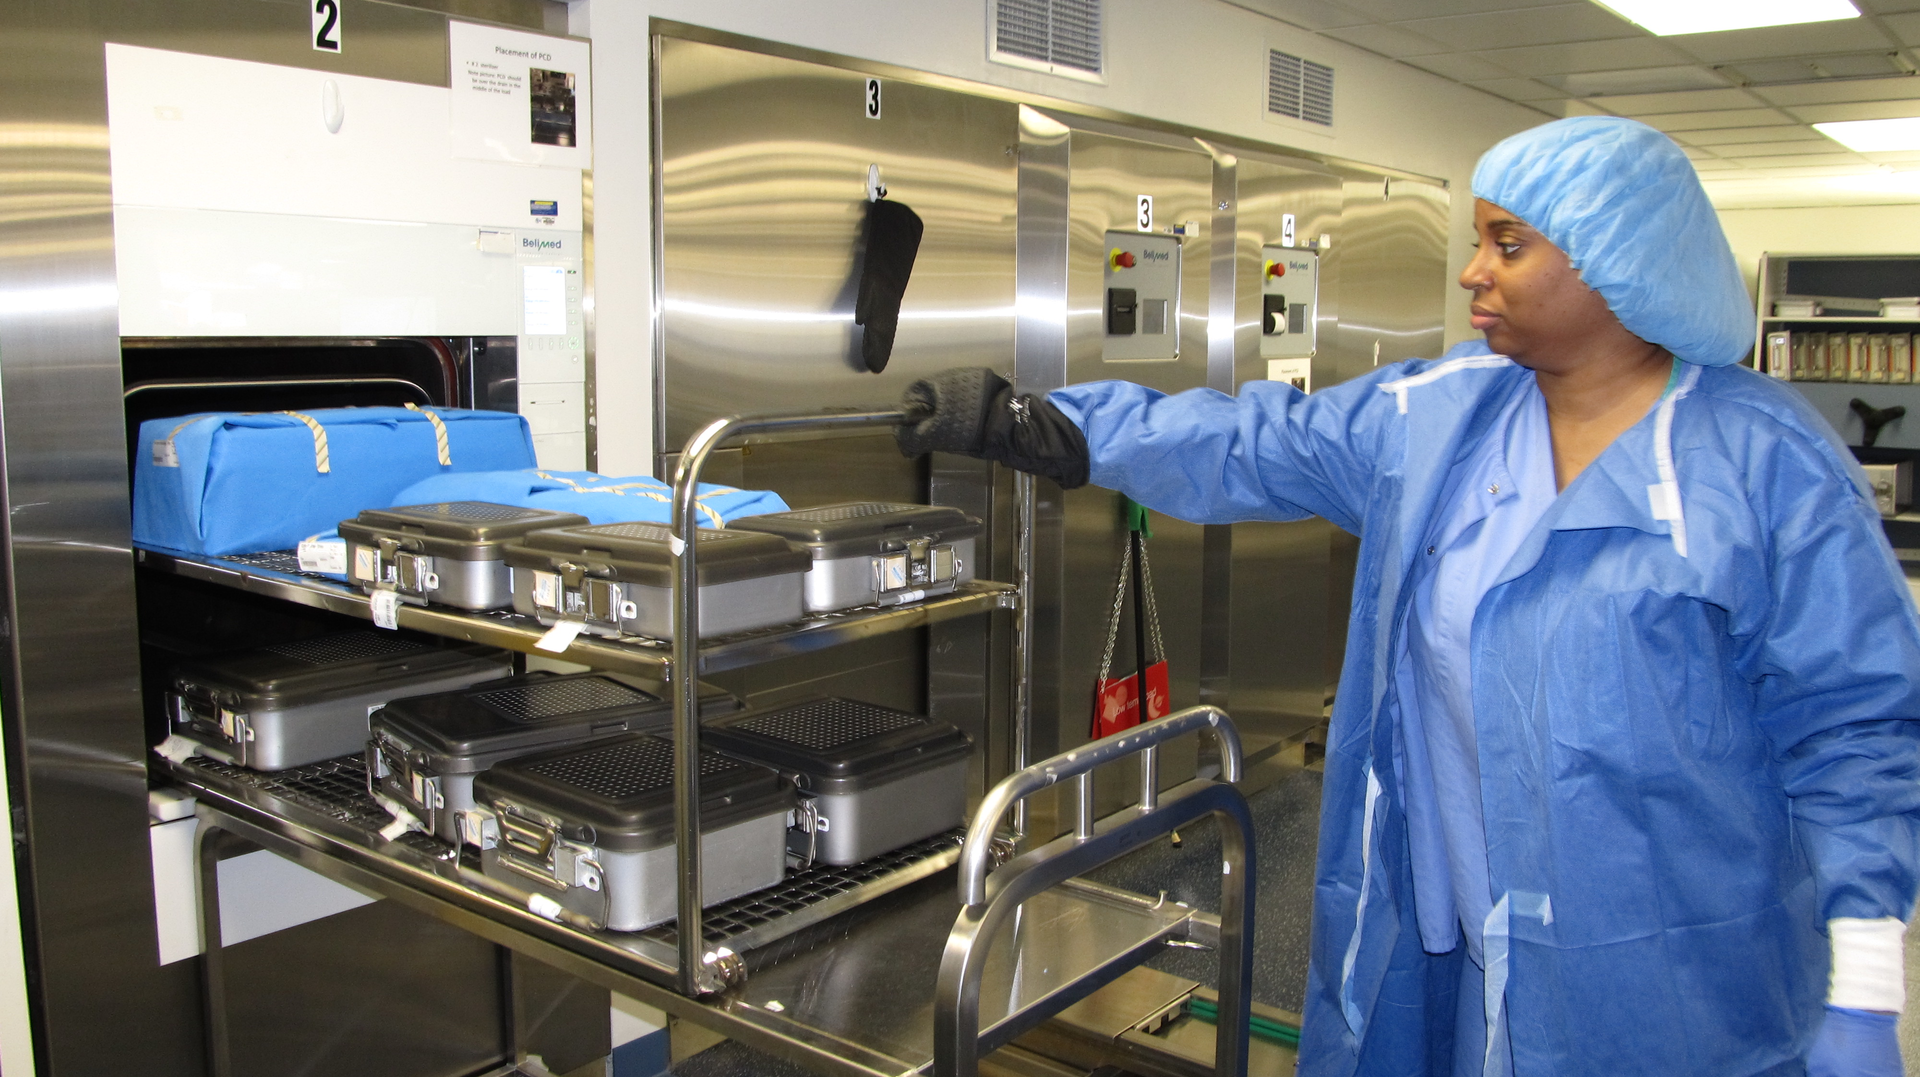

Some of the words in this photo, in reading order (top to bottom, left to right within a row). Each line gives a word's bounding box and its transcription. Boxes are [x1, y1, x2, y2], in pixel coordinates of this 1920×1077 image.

[316, 0, 338, 50] 2
[495, 46, 529, 59] Placement
[531, 52, 538, 60] of
[538, 53, 552, 61] PCD
[869, 80, 879, 117] 3
[1140, 198, 1150, 228] 3
[1285, 217, 1292, 243] 4
